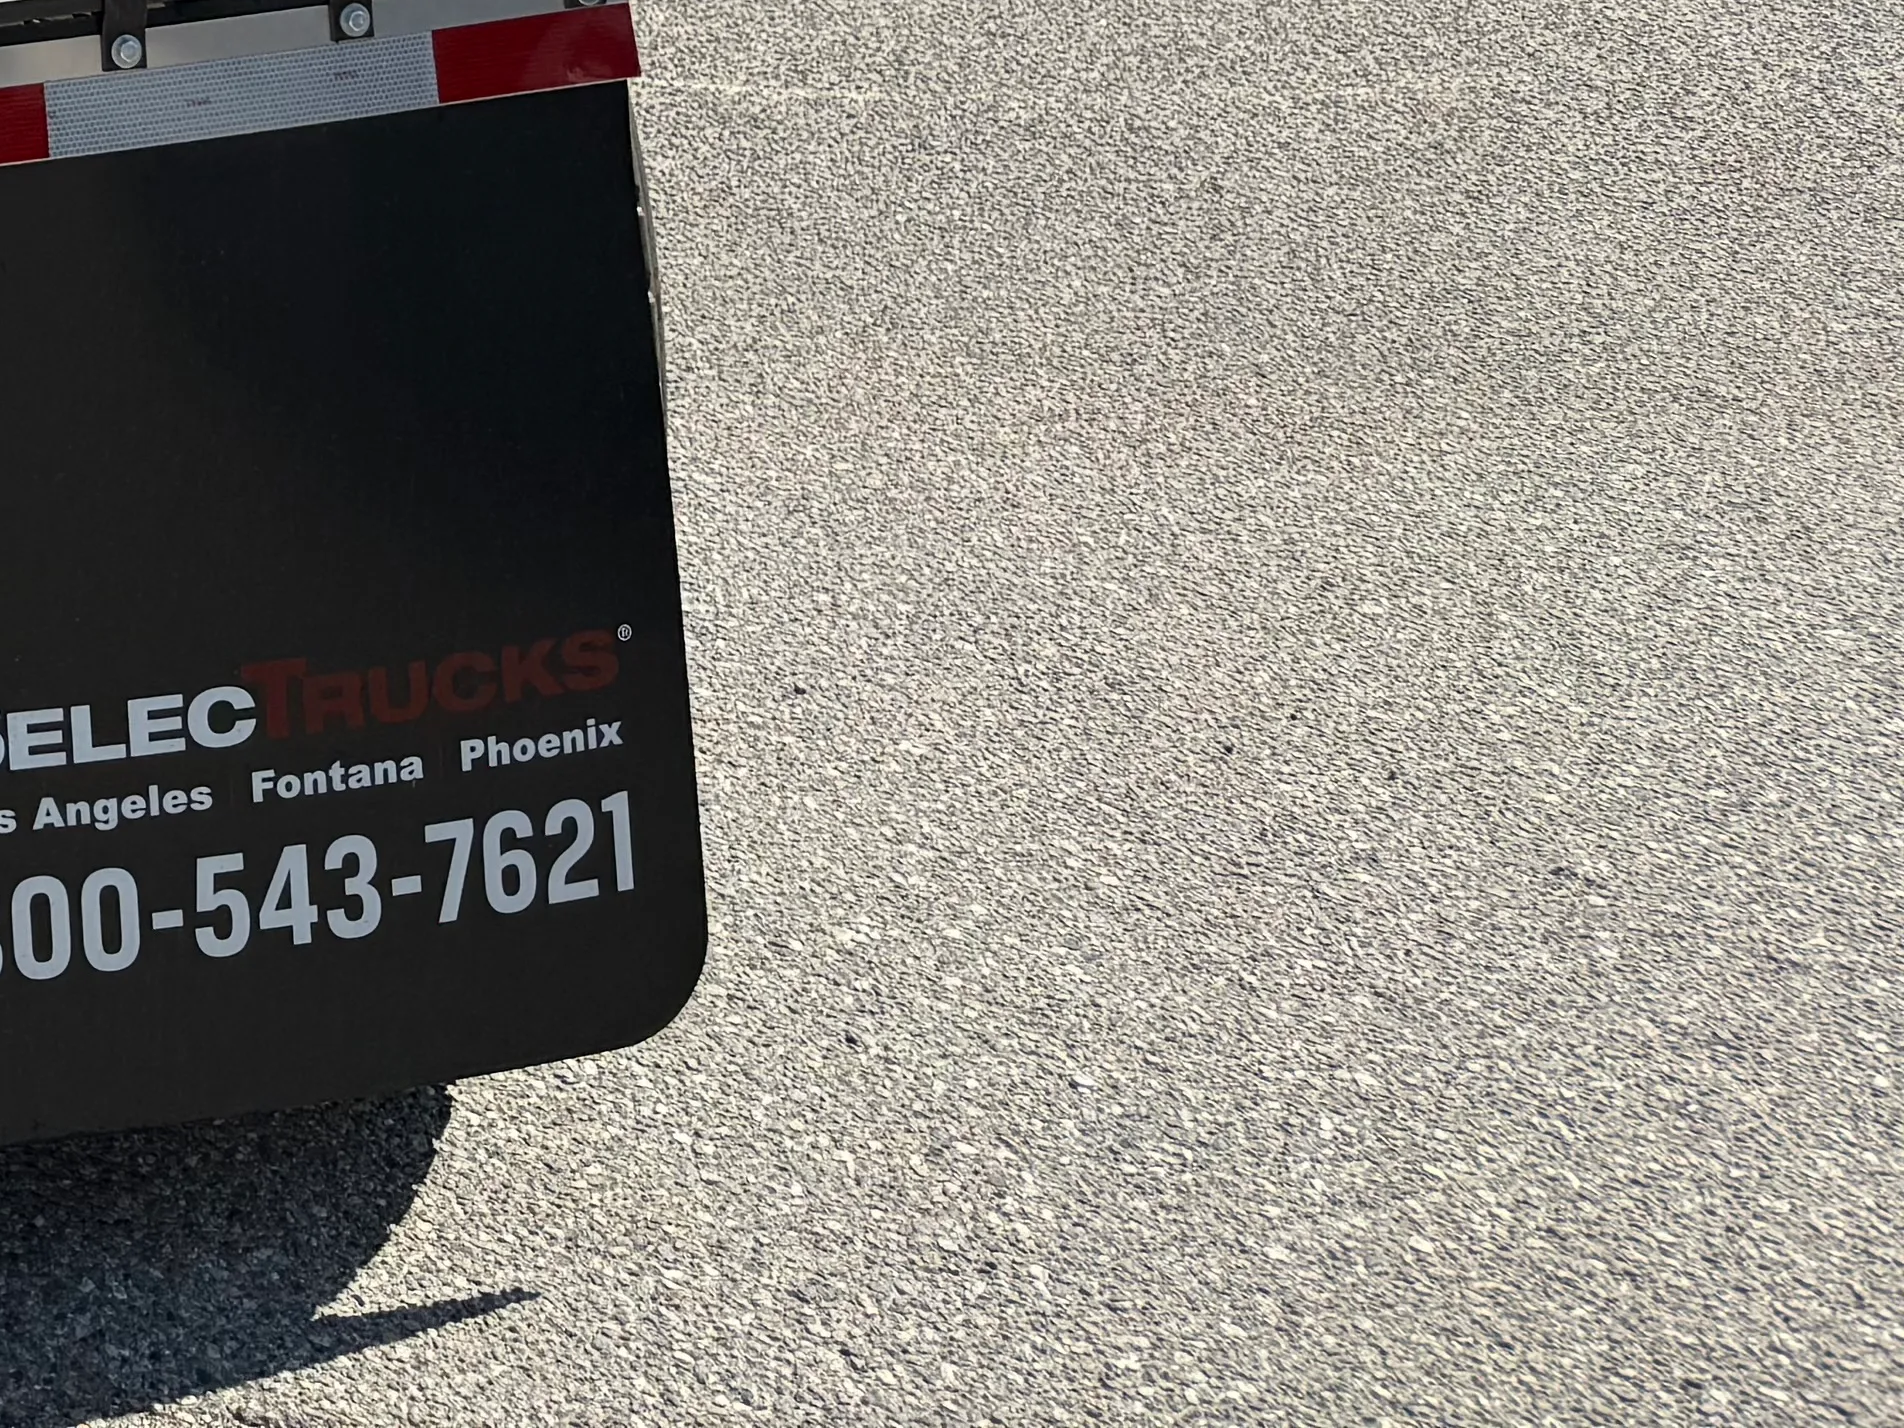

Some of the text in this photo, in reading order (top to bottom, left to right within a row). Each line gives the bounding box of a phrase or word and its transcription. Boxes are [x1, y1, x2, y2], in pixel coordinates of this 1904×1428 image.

[33, 785, 213, 832] Angeles
[252, 755, 424, 804] Fontana
[460, 717, 624, 772] Phoenix
